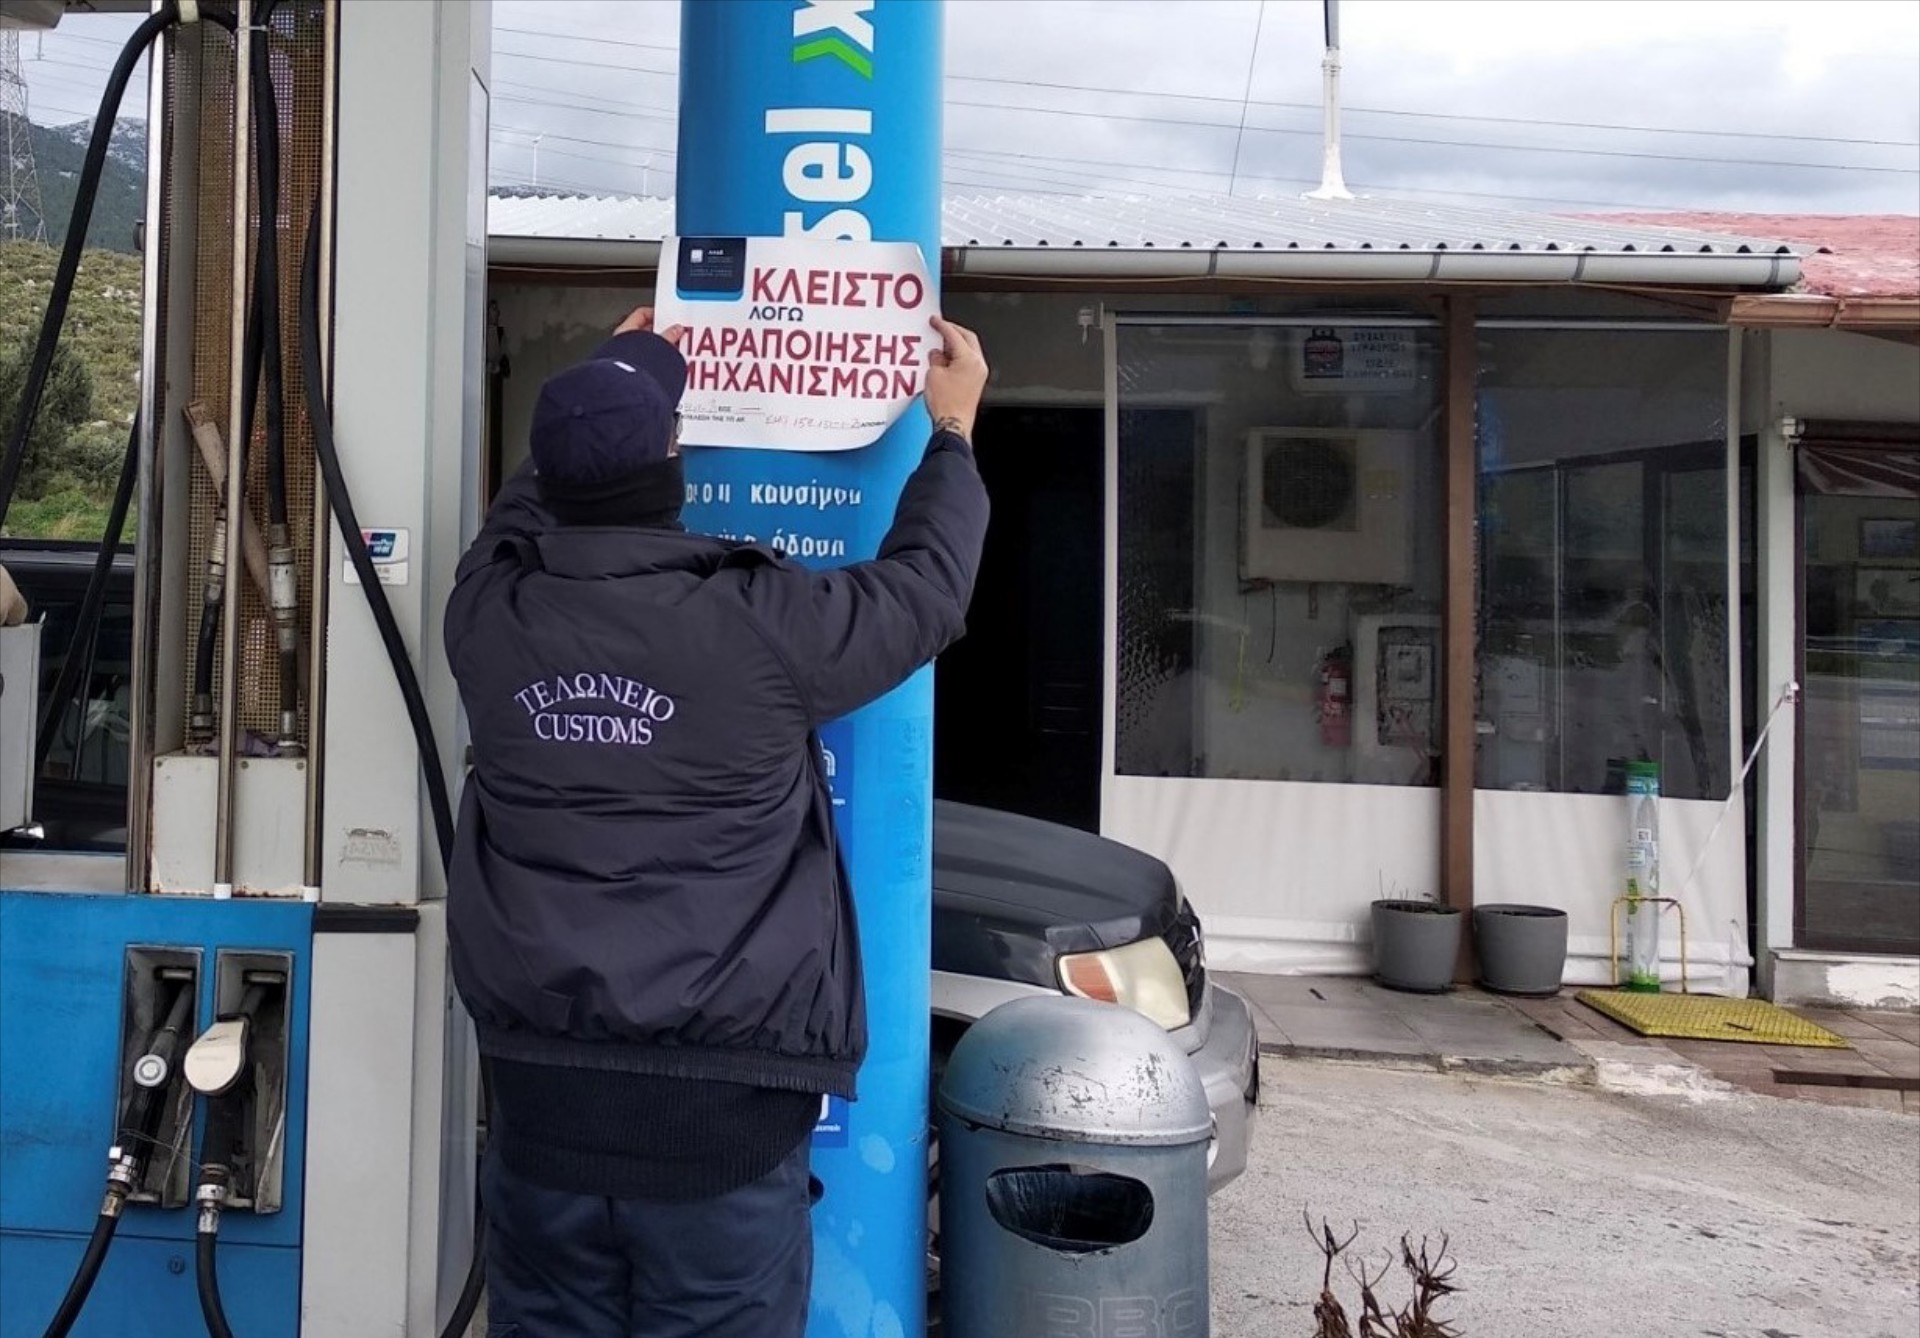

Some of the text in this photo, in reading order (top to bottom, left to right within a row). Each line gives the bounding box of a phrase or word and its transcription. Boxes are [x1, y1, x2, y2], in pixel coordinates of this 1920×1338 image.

[751, 267, 924, 310] ΚΛΕΙΣΤΟ
[749, 306, 804, 322] ΛΟΓΩ
[514, 673, 675, 722] ΤΕΛΩΝΕΙΟ
[534, 713, 653, 745] CUSTOMS
